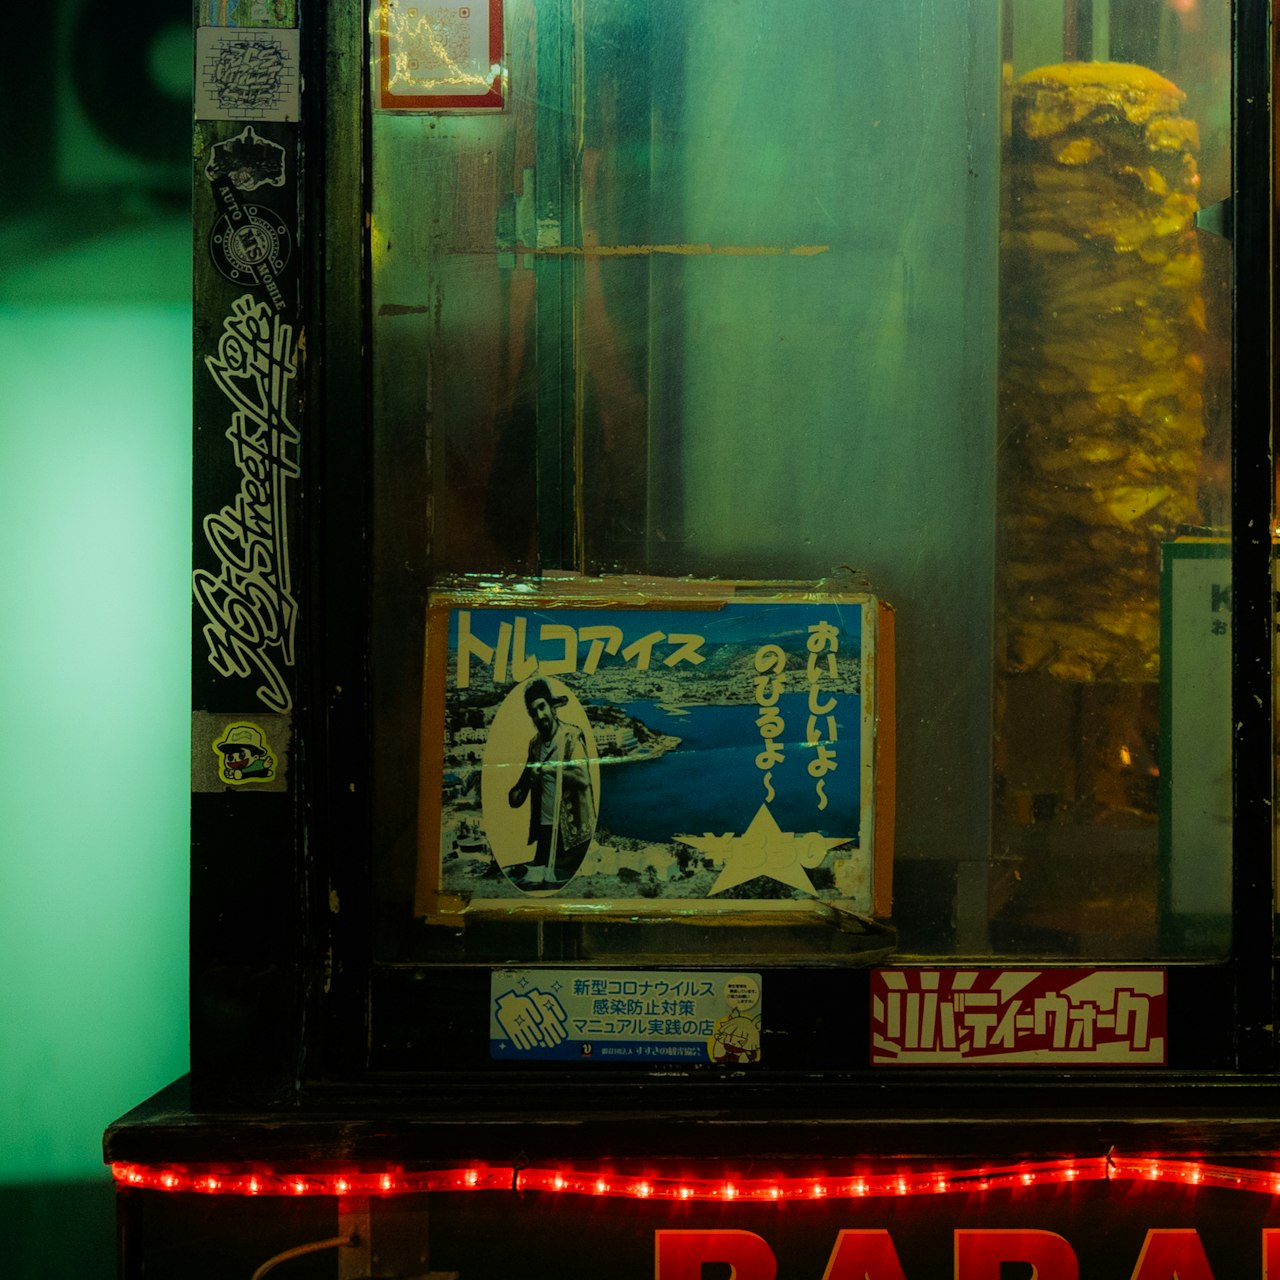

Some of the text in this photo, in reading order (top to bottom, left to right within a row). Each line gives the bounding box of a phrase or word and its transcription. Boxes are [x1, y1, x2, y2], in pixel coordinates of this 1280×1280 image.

[218, 185, 243, 221] AUTO
[455, 610, 706, 689] トルコアイス
[573, 978, 715, 997] 新型コロナウイルス
[592, 998, 696, 1017] 感染防止対策
[572, 1018, 715, 1037] マニュアル実践の店
